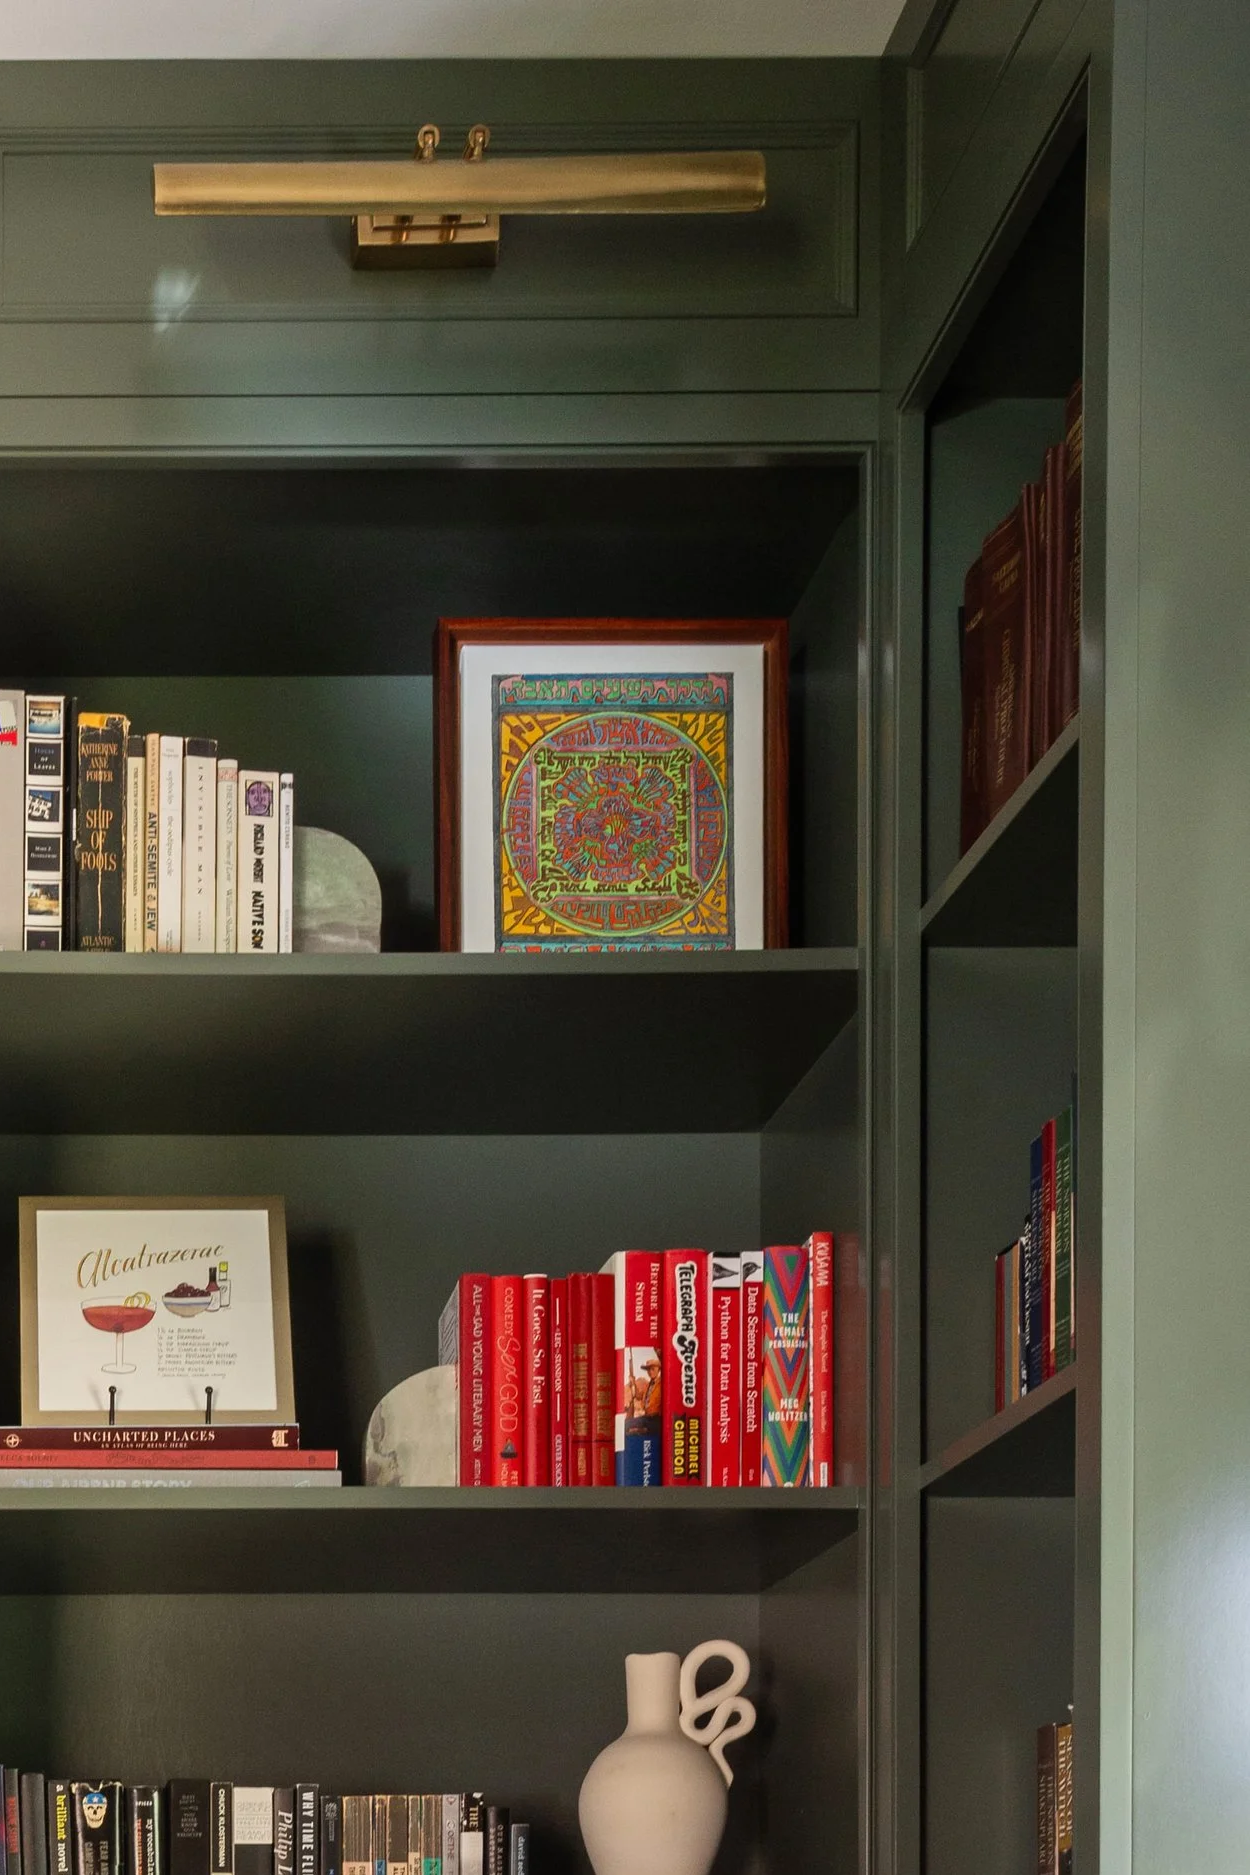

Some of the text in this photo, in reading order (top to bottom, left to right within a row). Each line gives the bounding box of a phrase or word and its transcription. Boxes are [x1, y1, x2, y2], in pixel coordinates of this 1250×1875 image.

[81, 743, 118, 757] KATHERINE
[90, 757, 108, 769] ANNE
[86, 771, 113, 782] PORTER
[85, 810, 113, 829] SHIP
[90, 830, 106, 847] OF
[81, 852, 117, 871] FOOLS
[76, 1242, 225, 1289] Alcatrazerac
[816, 1241, 831, 1288] KUSAMA
[650, 1262, 660, 1311] BEFORE
[676, 1265, 697, 1406] TELEGRAPH Avenue
[717, 1295, 731, 1444] Python for Data Analysis
[746, 1286, 759, 1433] Data Science from Scratch
[73, 1430, 216, 1443] UNCHARTED PLACES
[688, 1419, 700, 1475] MICHAEL
[302, 1792, 314, 1819] WHY
[218, 1788, 226, 1867] CHUCK KLOSTERMAN
[276, 1810, 293, 1861] Philip
[302, 1822, 314, 1853] TIME
[517, 1836, 525, 1857] david
